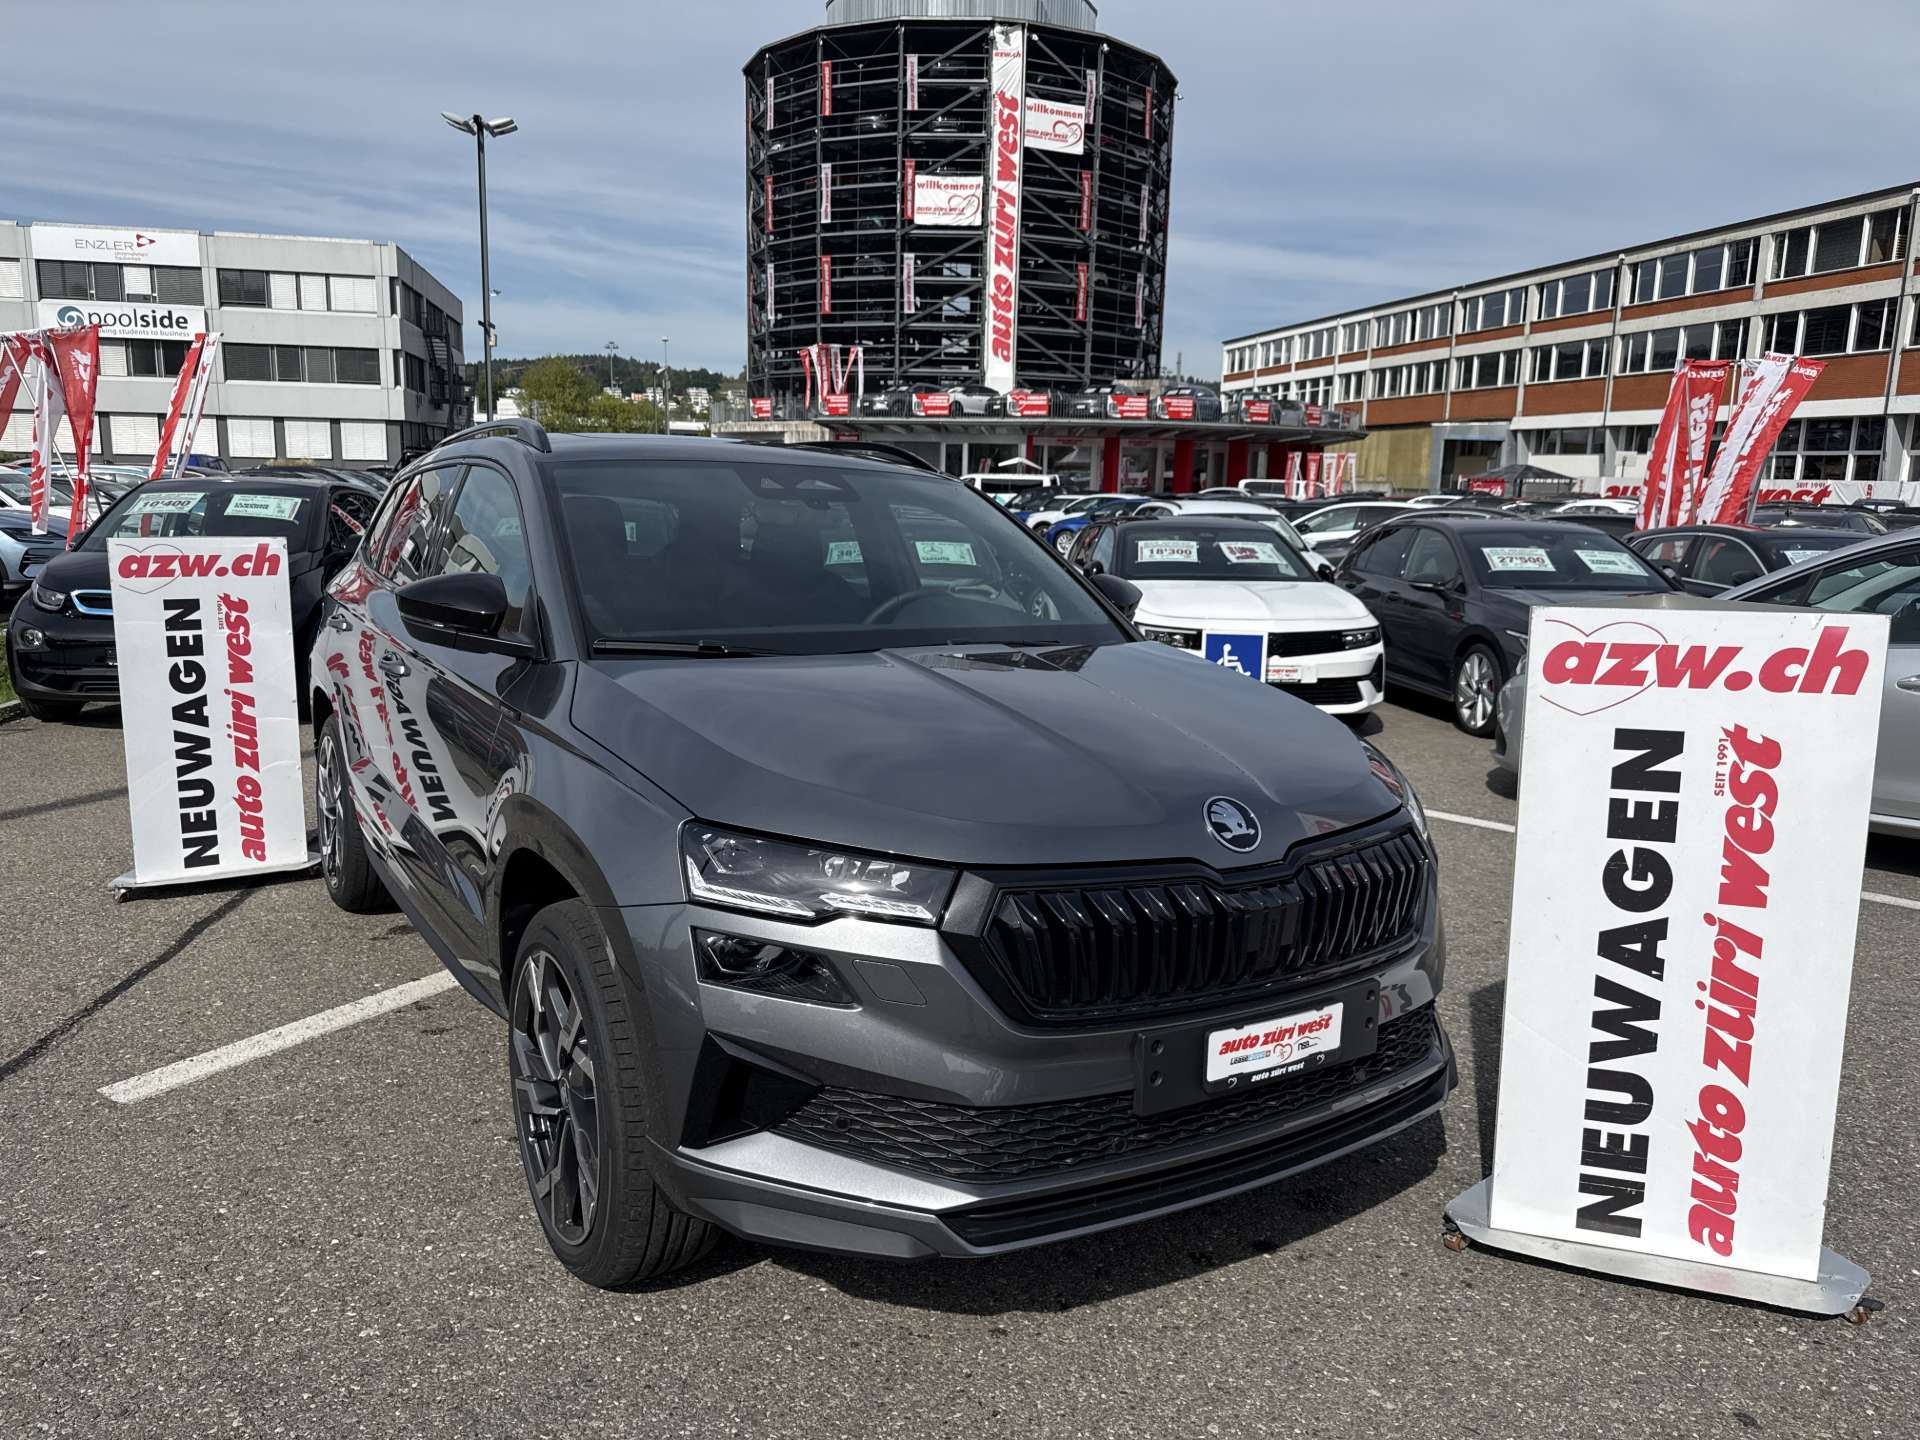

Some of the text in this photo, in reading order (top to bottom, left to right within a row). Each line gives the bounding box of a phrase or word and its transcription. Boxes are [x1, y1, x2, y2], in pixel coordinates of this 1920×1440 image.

[994, 50, 1021, 59] azw.ch
[1026, 103, 1083, 119] willkommen
[917, 180, 981, 191] willkommen
[74, 238, 134, 251] ENZLER
[989, 89, 1019, 363] auto züri west
[88, 308, 189, 330] poolside
[119, 328, 149, 336] students
[151, 329, 158, 337] to
[160, 330, 190, 338] business
[118, 543, 281, 578] azw.ch
[1542, 625, 1870, 696] azw.ch
[163, 598, 221, 868] NEUWAGEN
[218, 592, 266, 863] auto züri west
[1714, 737, 1729, 797] SEIT 1991
[1575, 727, 1685, 1239] NEUWAGEN
[1685, 723, 1782, 1257] auto züri west
[1218, 1033, 1261, 1056] auto
[1260, 1024, 1296, 1047] züri
[1297, 1013, 1333, 1037] west
[1251, 1070, 1270, 1082] auto
[1287, 1061, 1305, 1073] west
